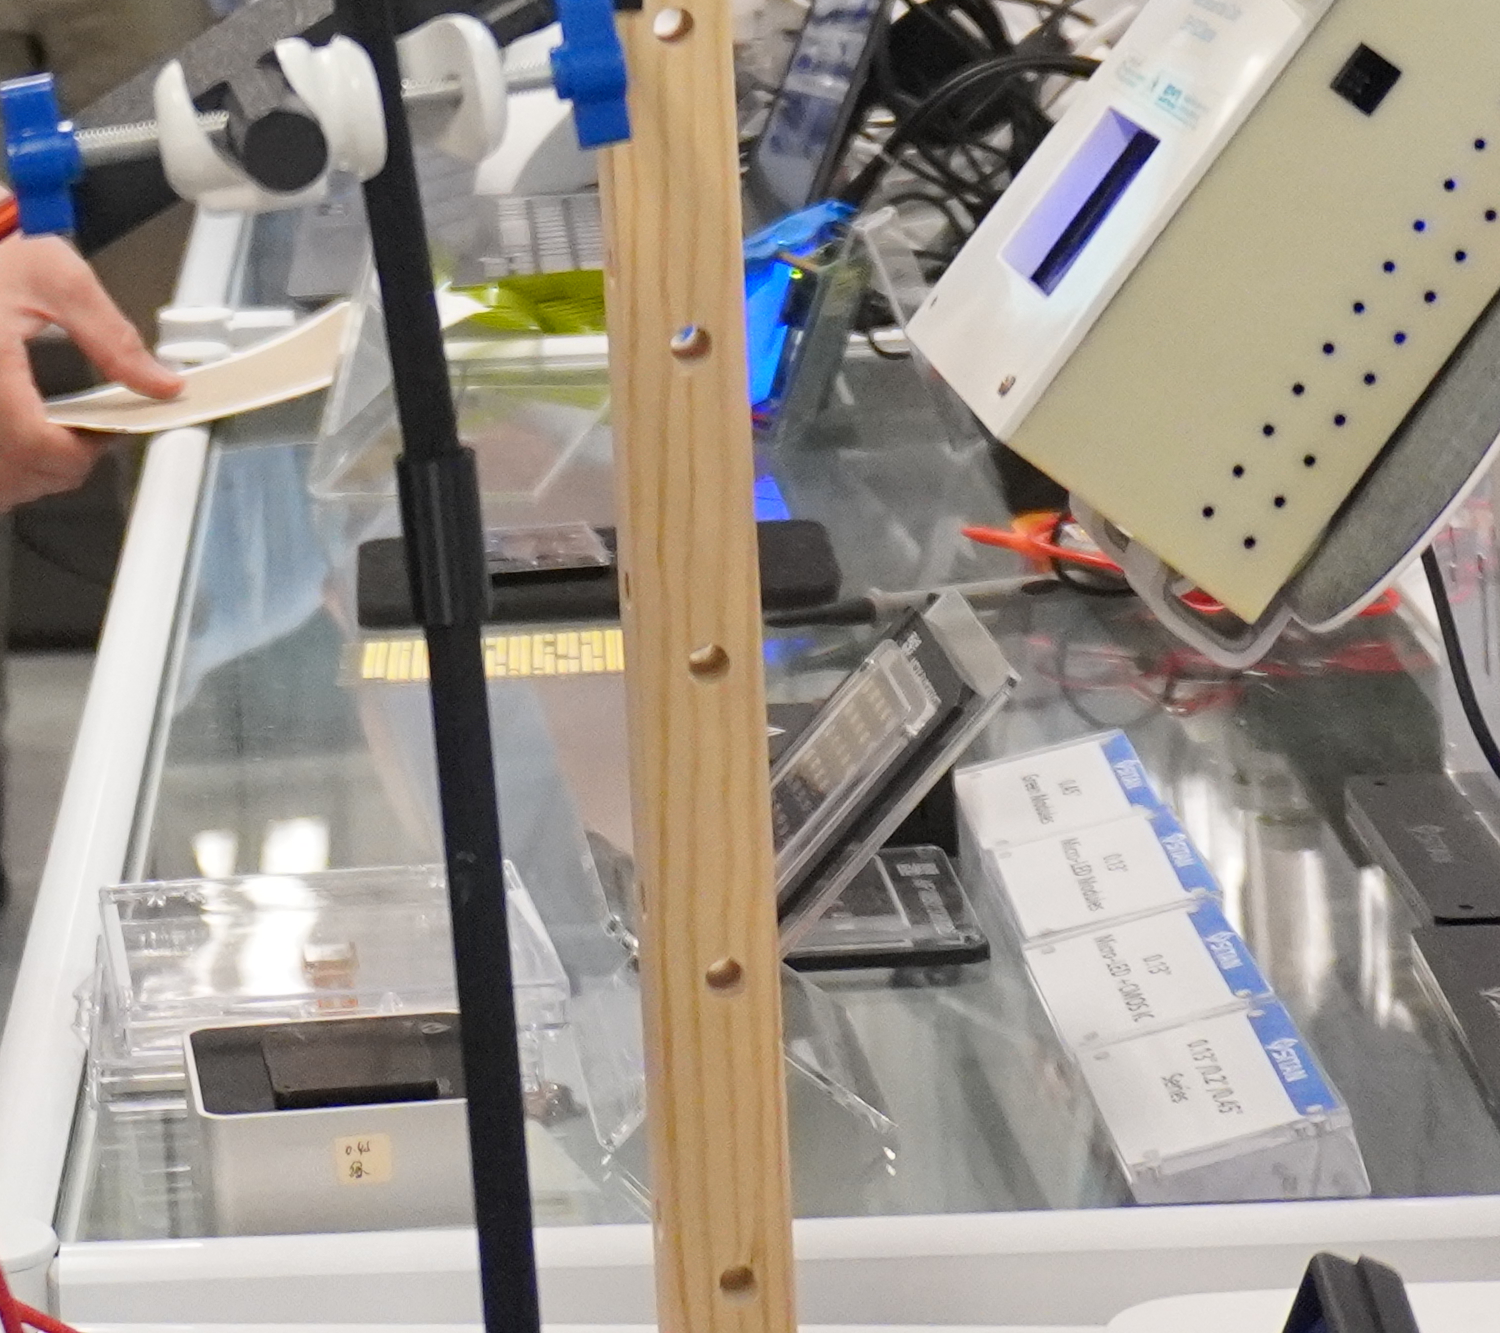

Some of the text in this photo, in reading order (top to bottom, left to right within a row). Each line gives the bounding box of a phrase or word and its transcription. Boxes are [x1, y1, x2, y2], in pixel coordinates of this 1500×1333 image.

[1216, 935, 1245, 970] SITAN
[1274, 1047, 1308, 1083] SITAN
[1160, 1072, 1190, 1105] Series
